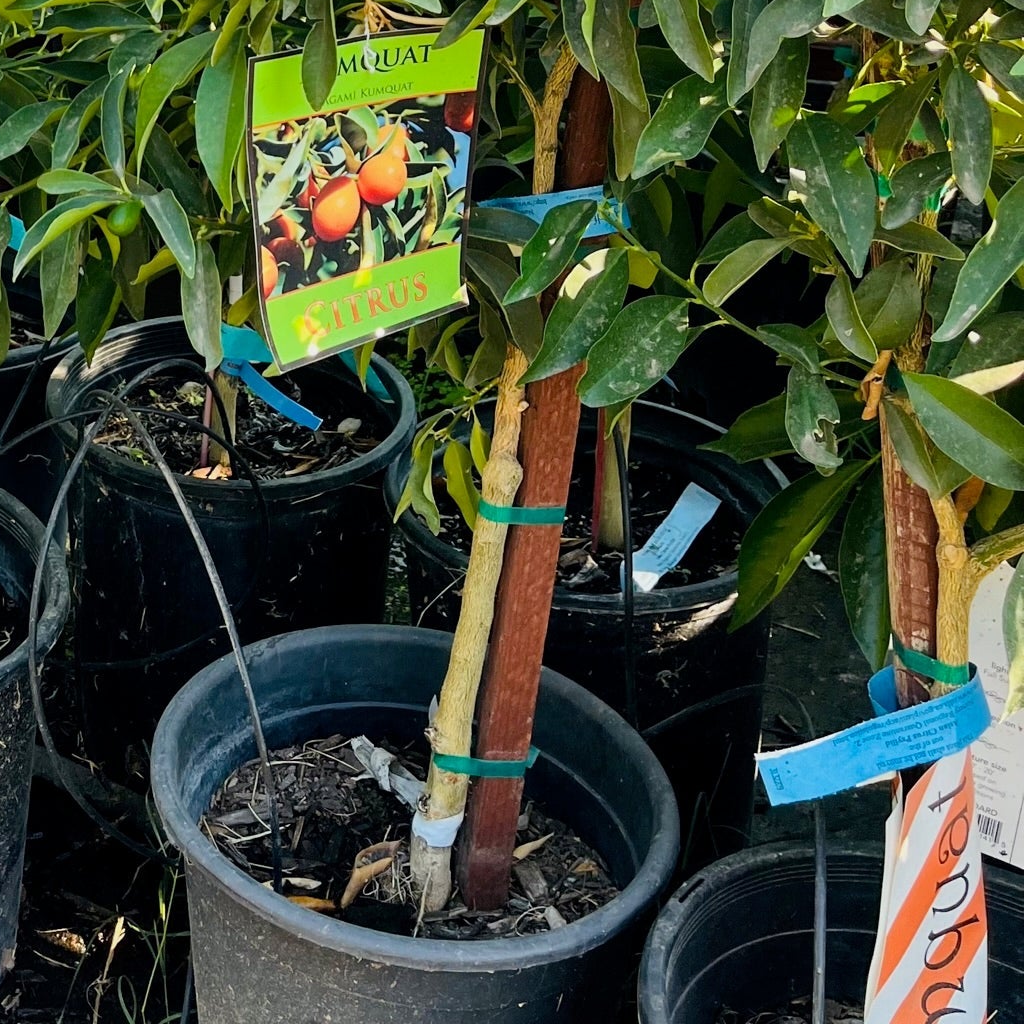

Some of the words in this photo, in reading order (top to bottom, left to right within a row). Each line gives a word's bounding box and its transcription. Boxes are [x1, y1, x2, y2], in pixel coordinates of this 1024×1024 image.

[336, 44, 433, 75] MQUAT
[322, 89, 357, 106] GAMI
[360, 81, 415, 99] KUMQUAT
[304, 271, 429, 337] CITRUS
[912, 727, 937, 740] Citrus
[920, 775, 980, 1024] mquat
